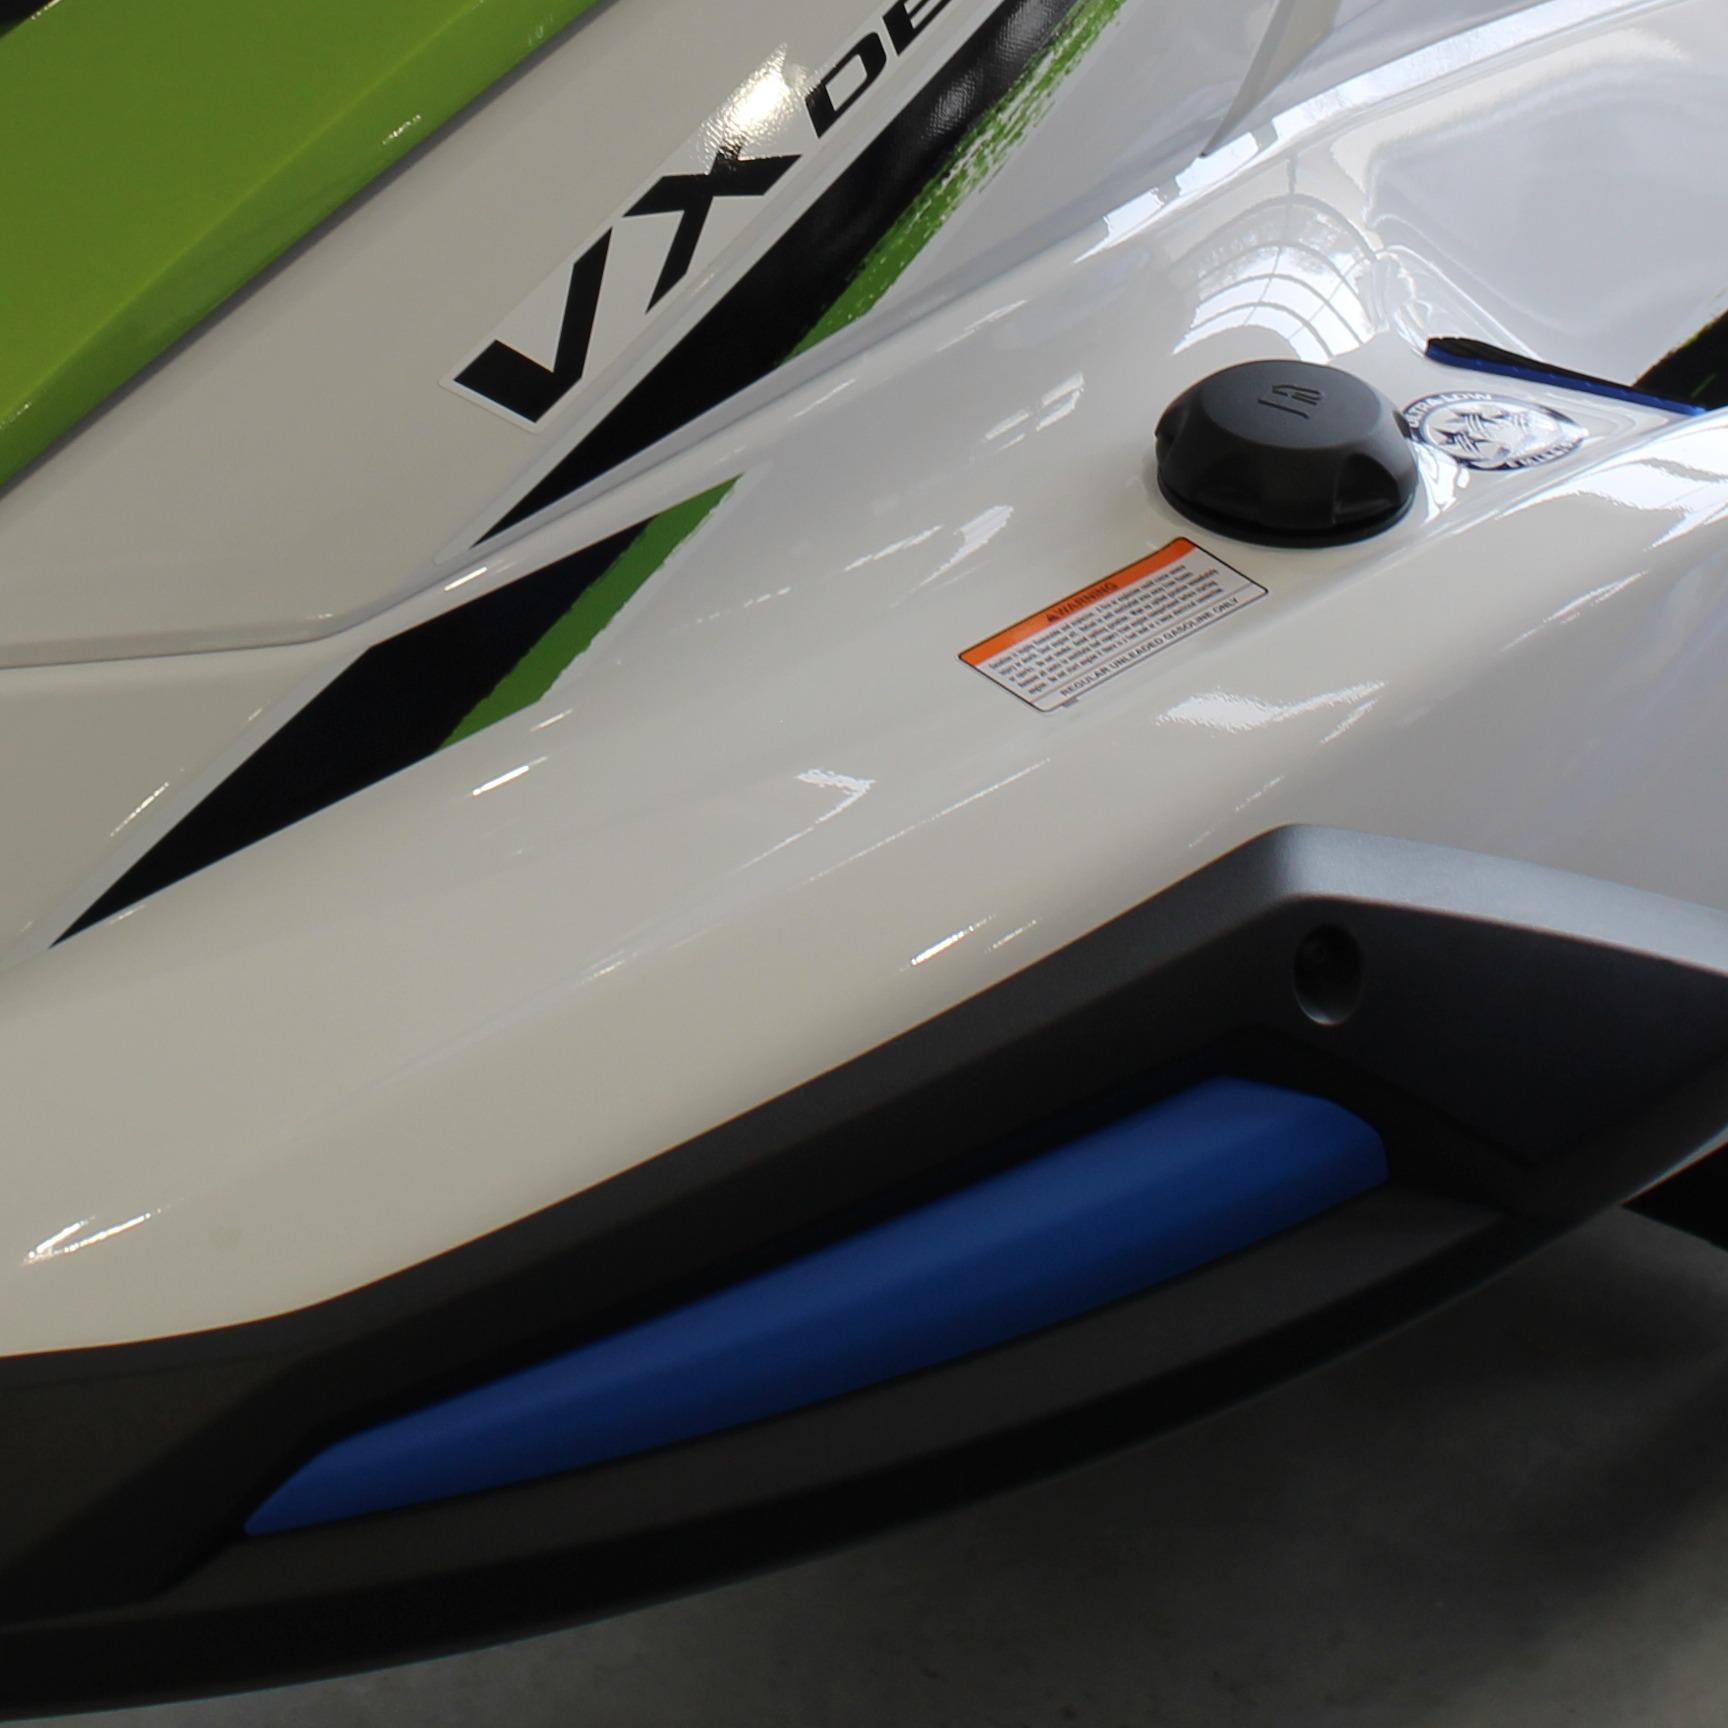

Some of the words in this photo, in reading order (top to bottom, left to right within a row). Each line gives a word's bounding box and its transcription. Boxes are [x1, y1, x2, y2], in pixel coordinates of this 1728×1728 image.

[453, 122, 803, 424] VX
[1057, 582, 1120, 617] WARNING
[1060, 665, 1111, 697] REGULAR
[1108, 636, 1164, 669] UNLEADED
[1162, 611, 1212, 640] GASOLINE
[1211, 597, 1239, 614] ONLY
